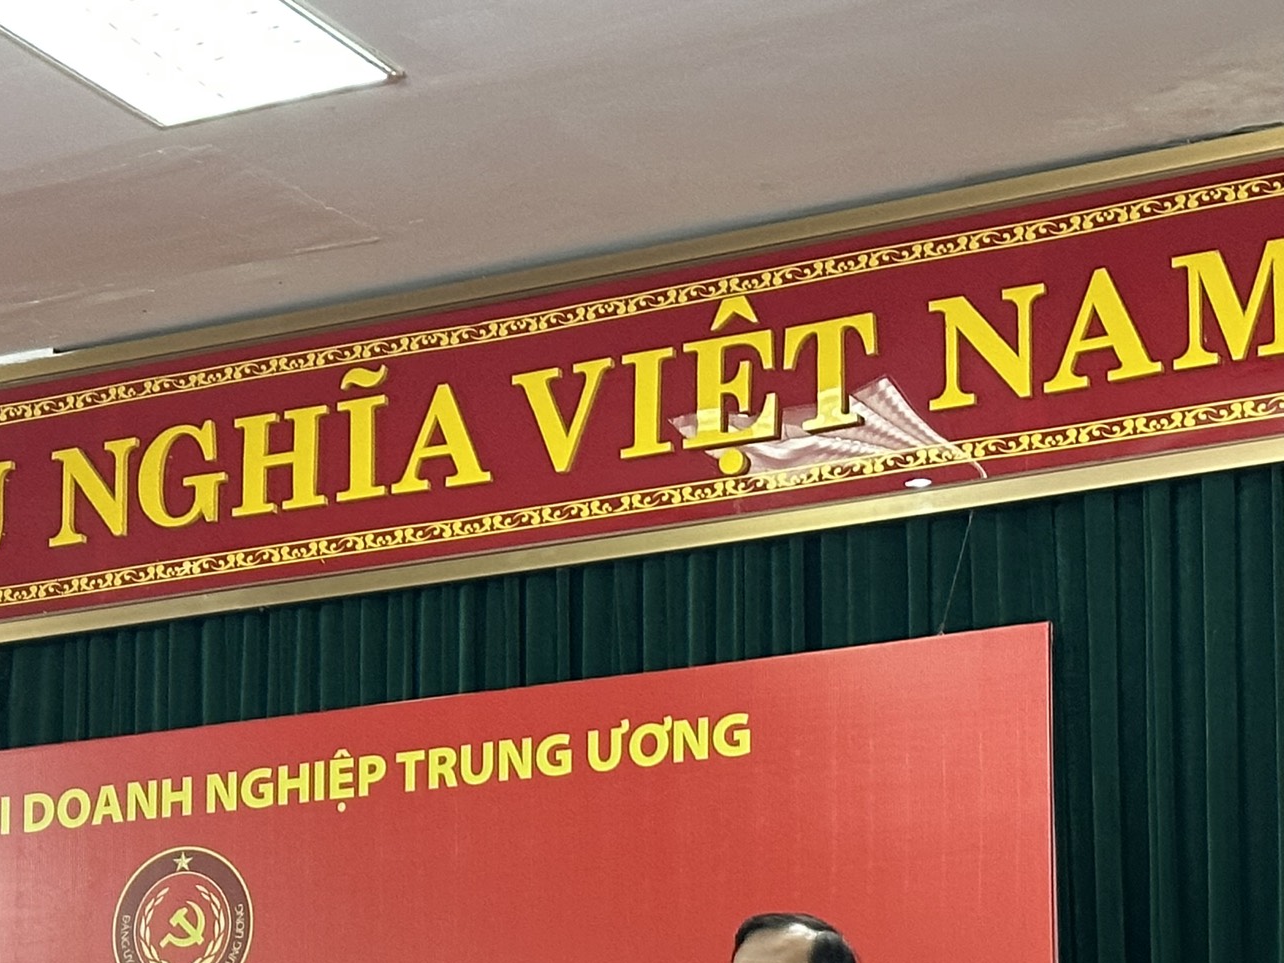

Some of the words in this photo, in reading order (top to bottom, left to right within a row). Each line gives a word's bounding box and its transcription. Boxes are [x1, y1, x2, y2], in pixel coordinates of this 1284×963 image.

[49, 366, 493, 548] NGHĨA
[512, 297, 879, 475] VIỆT
[927, 237, 1284, 412] NAM
[23, 776, 194, 833] DOANH
[205, 749, 387, 813] NGHIỆP
[396, 733, 573, 792] TRUNG
[587, 713, 752, 772] ƯƠNG
